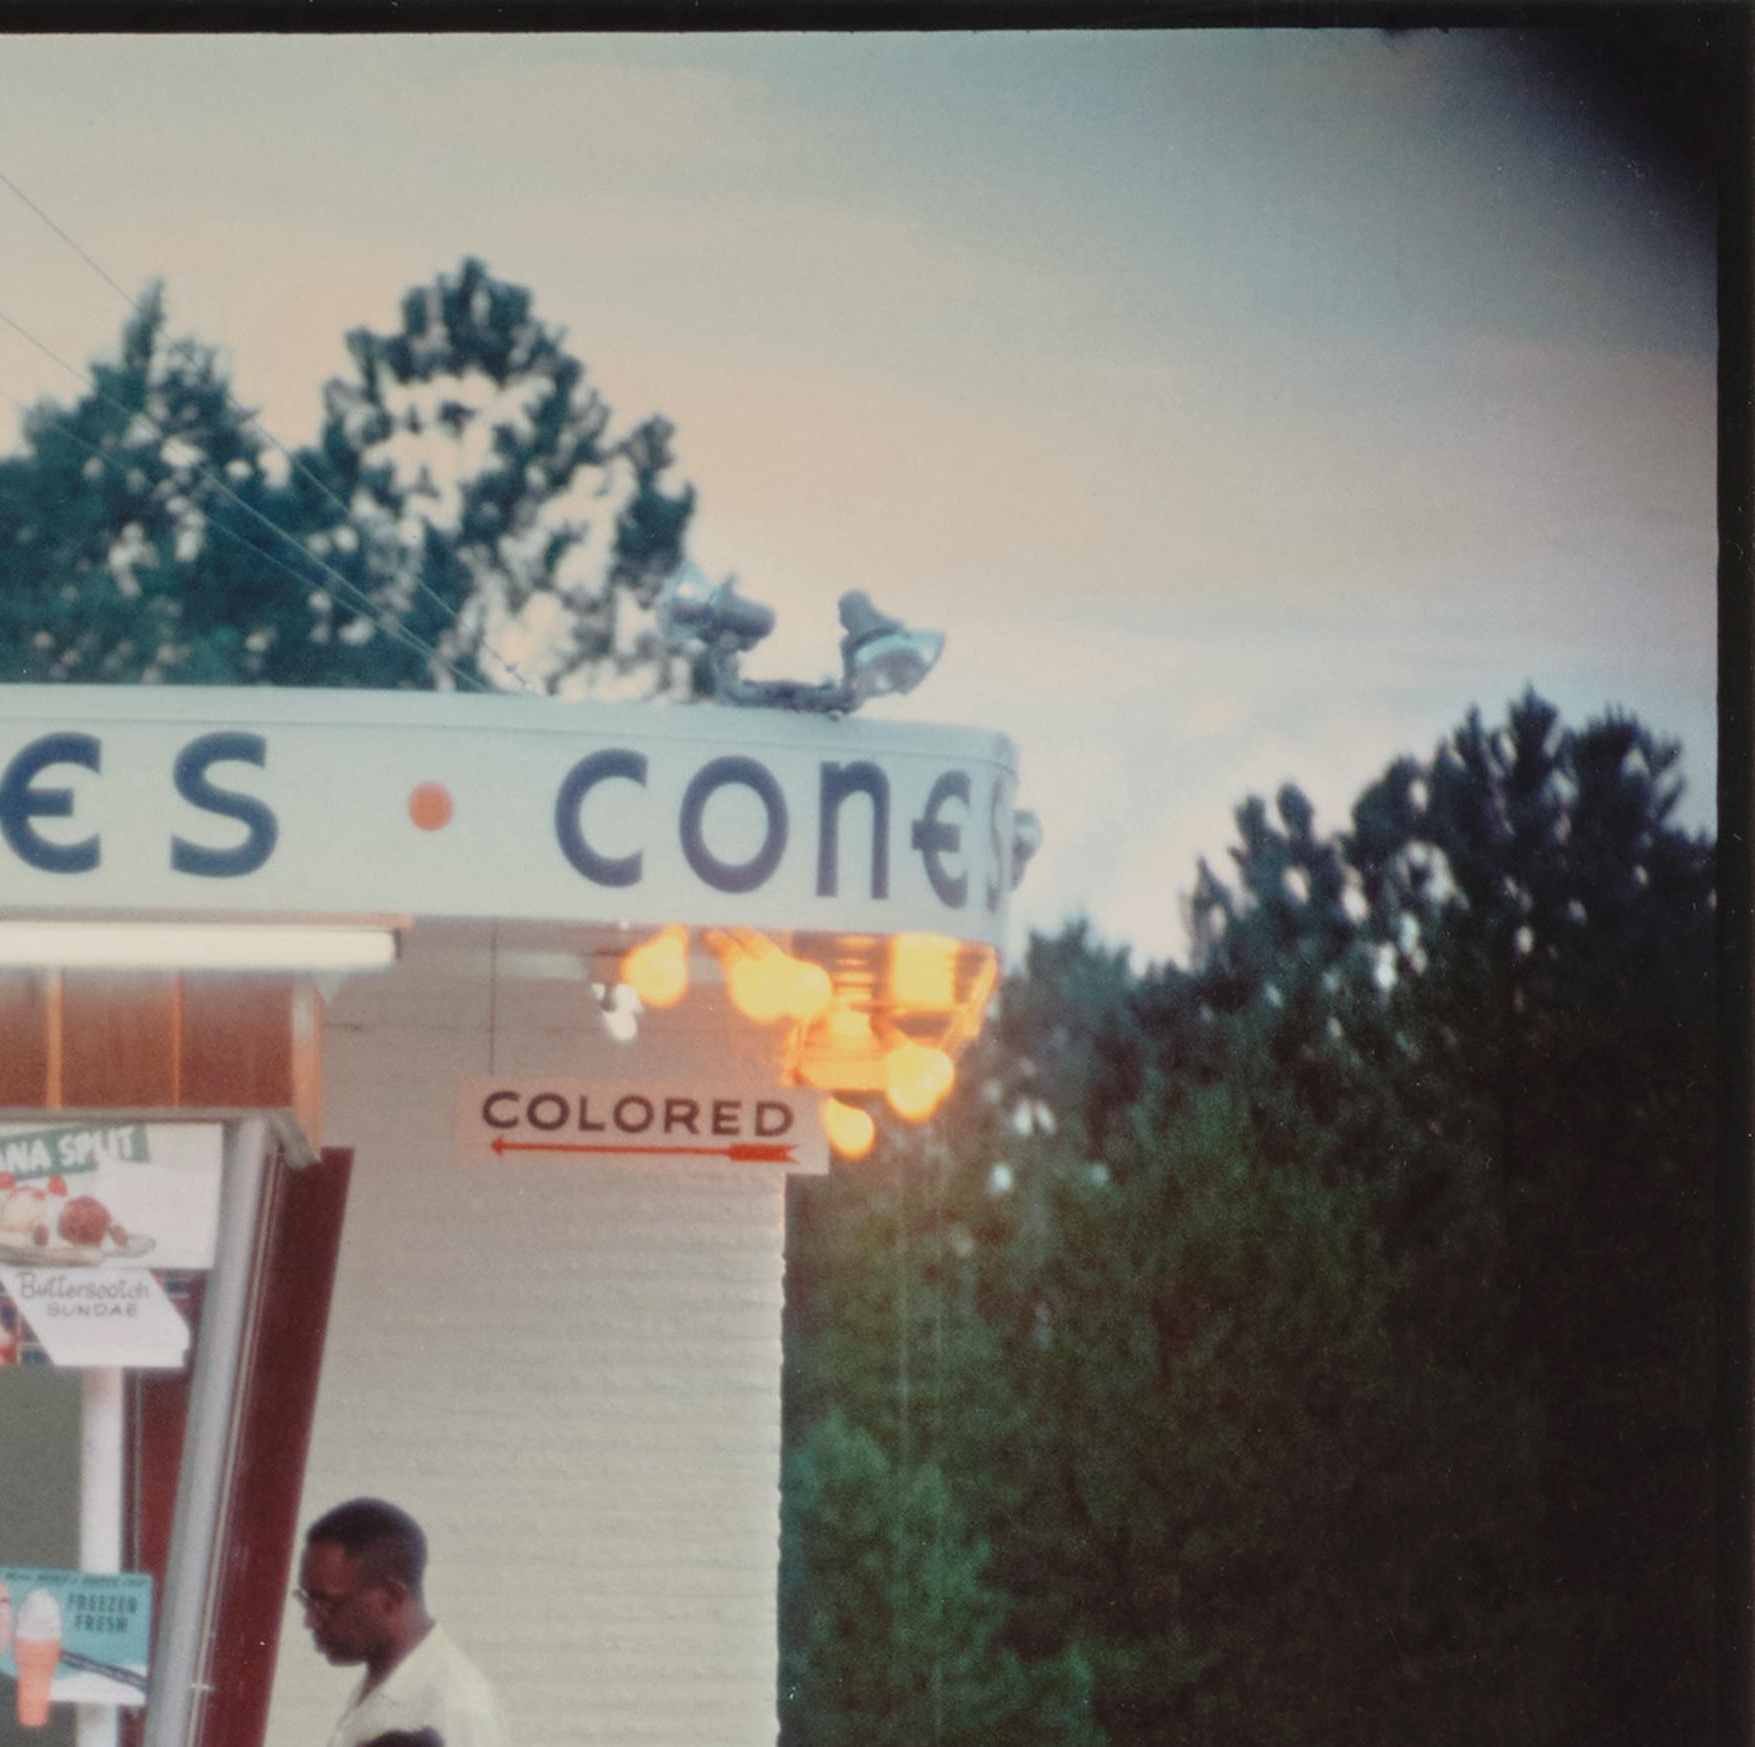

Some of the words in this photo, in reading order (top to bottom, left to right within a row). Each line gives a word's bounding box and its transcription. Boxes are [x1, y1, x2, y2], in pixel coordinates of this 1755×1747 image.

[481, 1090, 795, 1138] COLORED
[57, 1126, 137, 1168] SPLIT
[17, 1270, 150, 1301] Butterscotch
[47, 1303, 140, 1319] SUNDAE
[67, 1592, 138, 1614] FREEZER
[75, 1614, 128, 1633] FRESH
